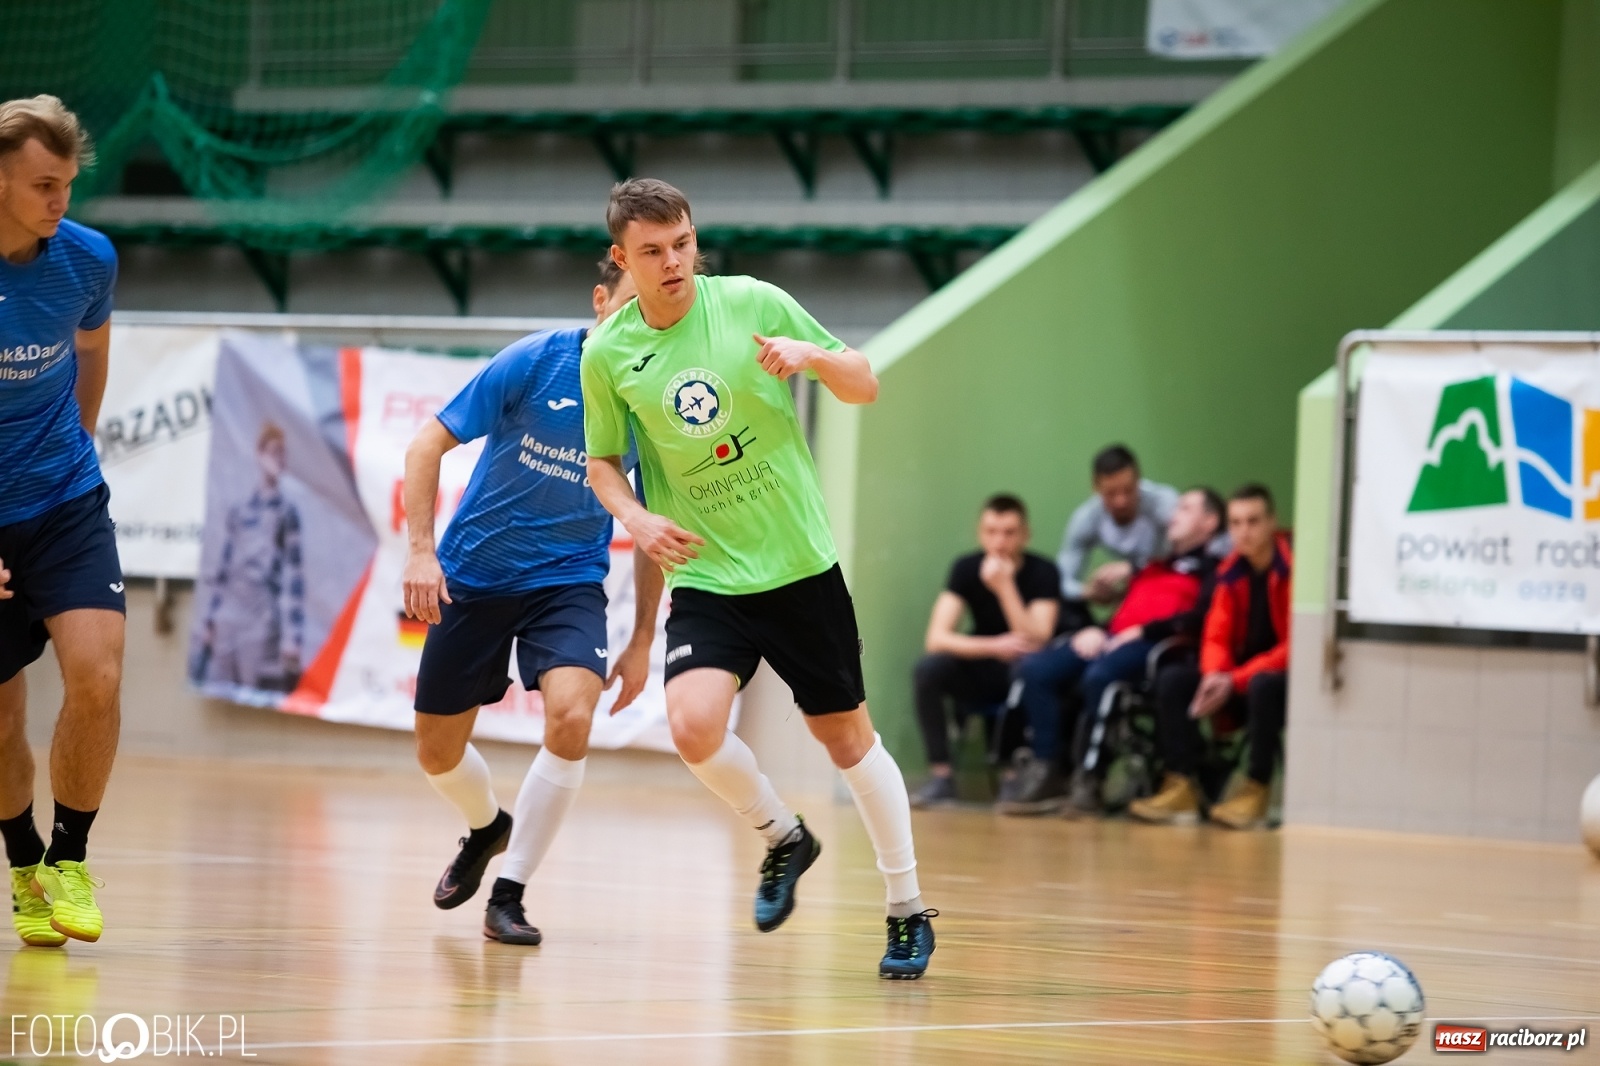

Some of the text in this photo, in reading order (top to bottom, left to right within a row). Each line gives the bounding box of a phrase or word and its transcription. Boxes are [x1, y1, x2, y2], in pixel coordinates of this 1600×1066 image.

[665, 371, 720, 405] FOOTBALL
[682, 409, 727, 434] MANIAC
[689, 460, 774, 500] OKINAWA
[735, 494, 745, 504] &
